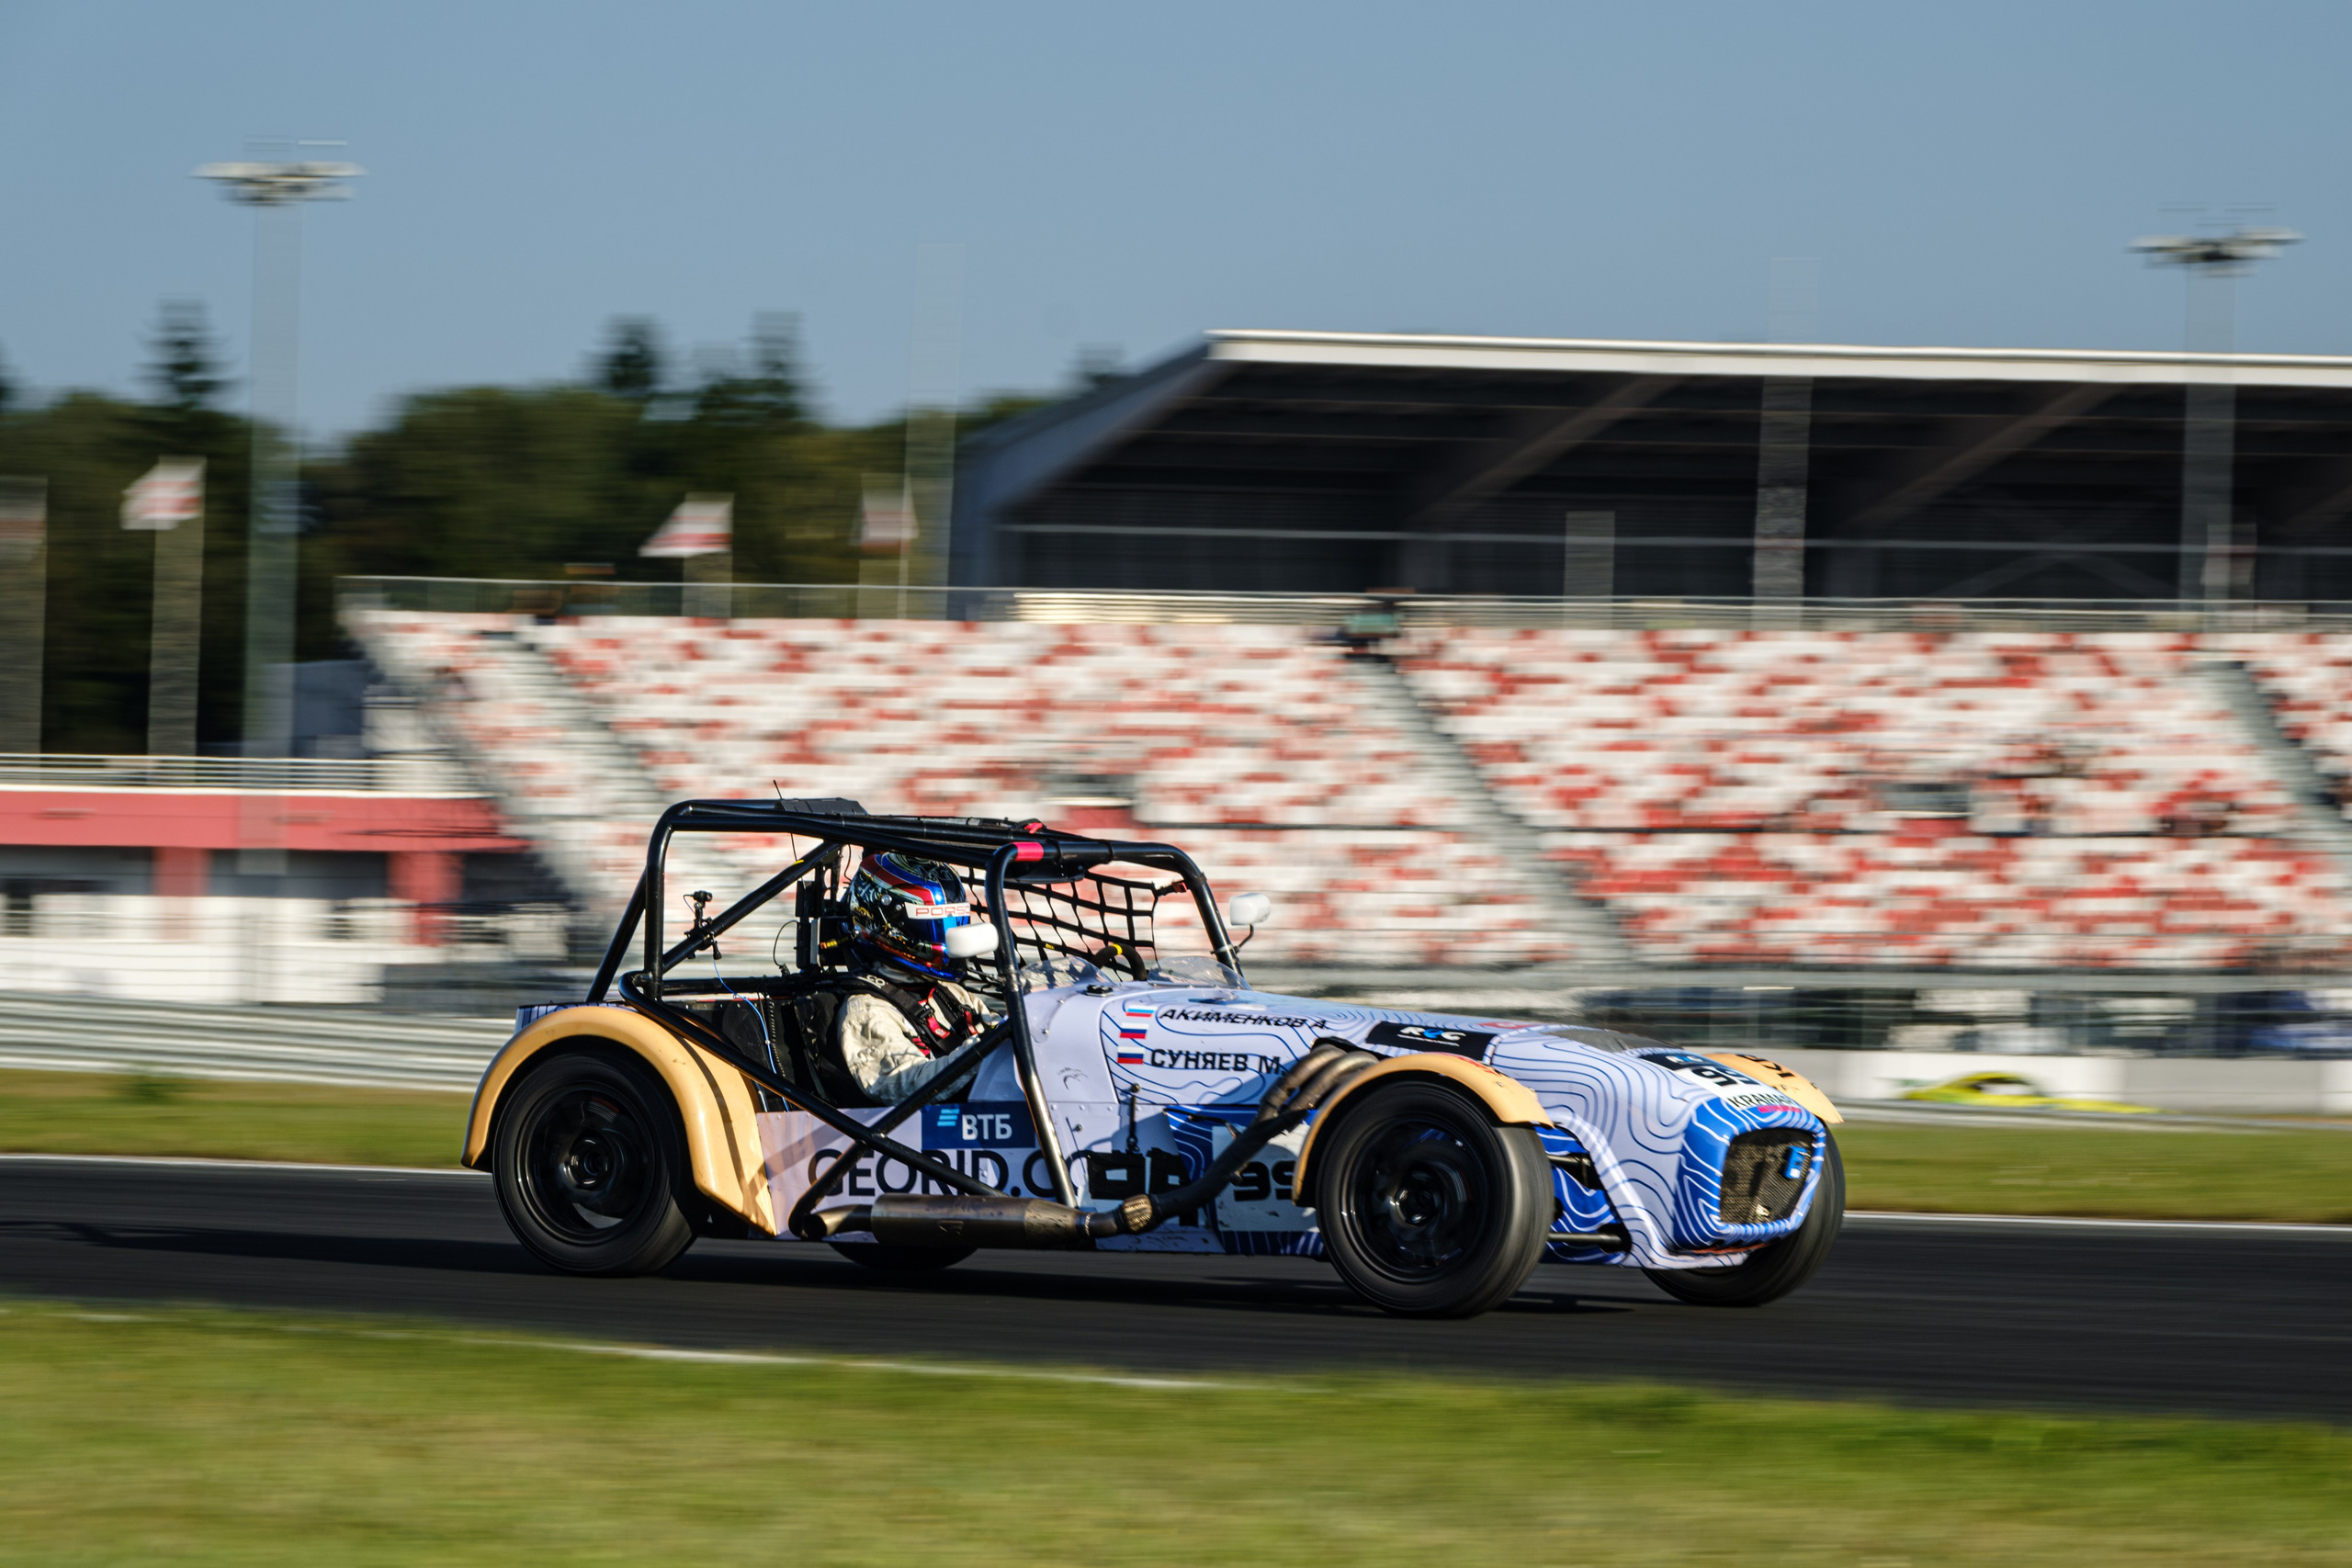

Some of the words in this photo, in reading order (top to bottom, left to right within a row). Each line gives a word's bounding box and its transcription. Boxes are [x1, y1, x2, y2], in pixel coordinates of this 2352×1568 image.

[1159, 1009, 1306, 1029] АКИМЕНКОВ
[1150, 1048, 1249, 1073] СУНЯЕВ
[1690, 1066, 1761, 1088] 99
[962, 1113, 1013, 1141] ВТБ
